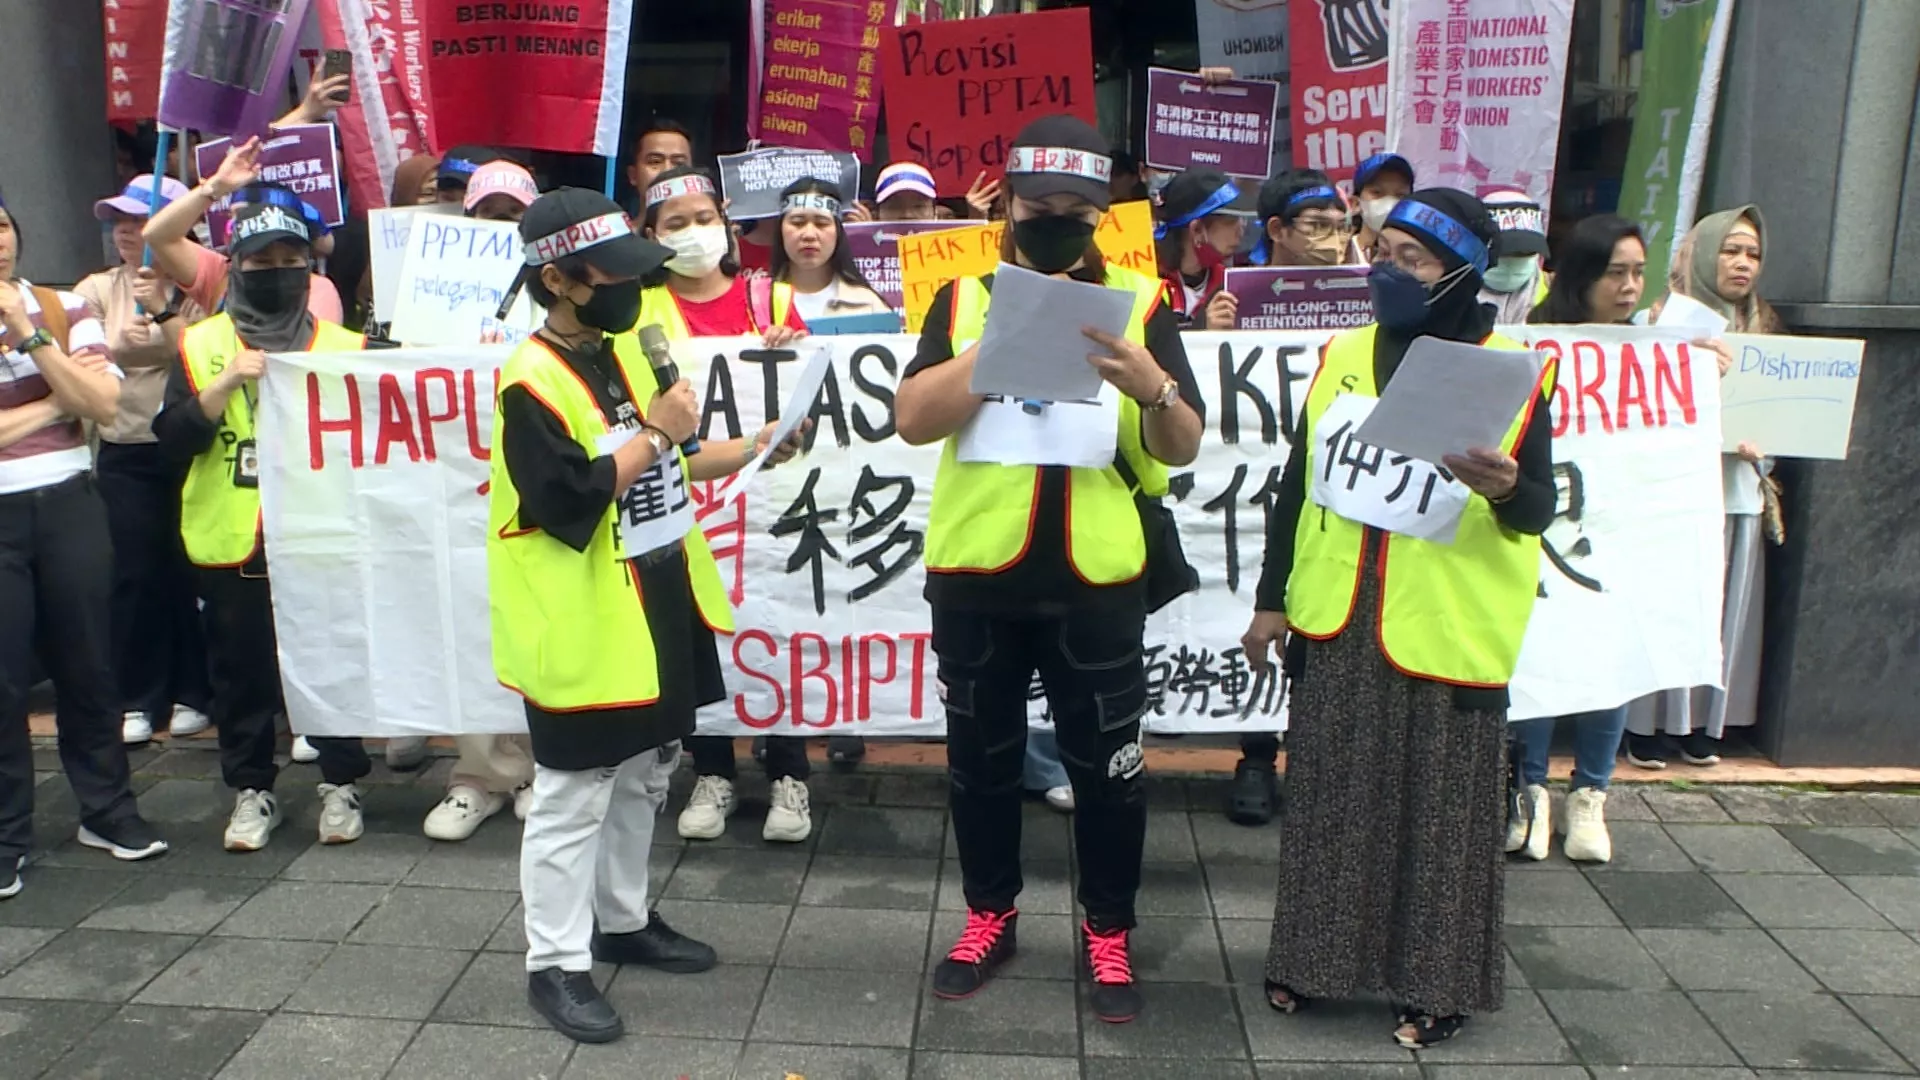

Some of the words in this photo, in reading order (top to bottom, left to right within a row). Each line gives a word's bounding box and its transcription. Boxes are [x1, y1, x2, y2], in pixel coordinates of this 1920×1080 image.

[456, 5, 580, 23] BERJUANG
[1469, 16, 1548, 38] NATIONAL
[431, 36, 506, 56] PASTI
[515, 36, 601, 56] MENANG
[1468, 45, 1549, 67] DOMESTIC
[769, 63, 848, 89] erumahan
[1413, 21, 1442, 124] 產業工會
[958, 76, 1076, 117] PPTM
[1464, 107, 1508, 126] UNION
[1304, 127, 1386, 170] the
[421, 221, 513, 260] PPTM
[535, 215, 613, 261] HAPUS
[855, 257, 881, 268] TOP
[902, 236, 965, 271] HAK
[1261, 303, 1288, 315] THE
[1290, 301, 1374, 314] LONG-TERM
[1241, 314, 1319, 329] RETENTION
[732, 629, 933, 728] SBIPT
